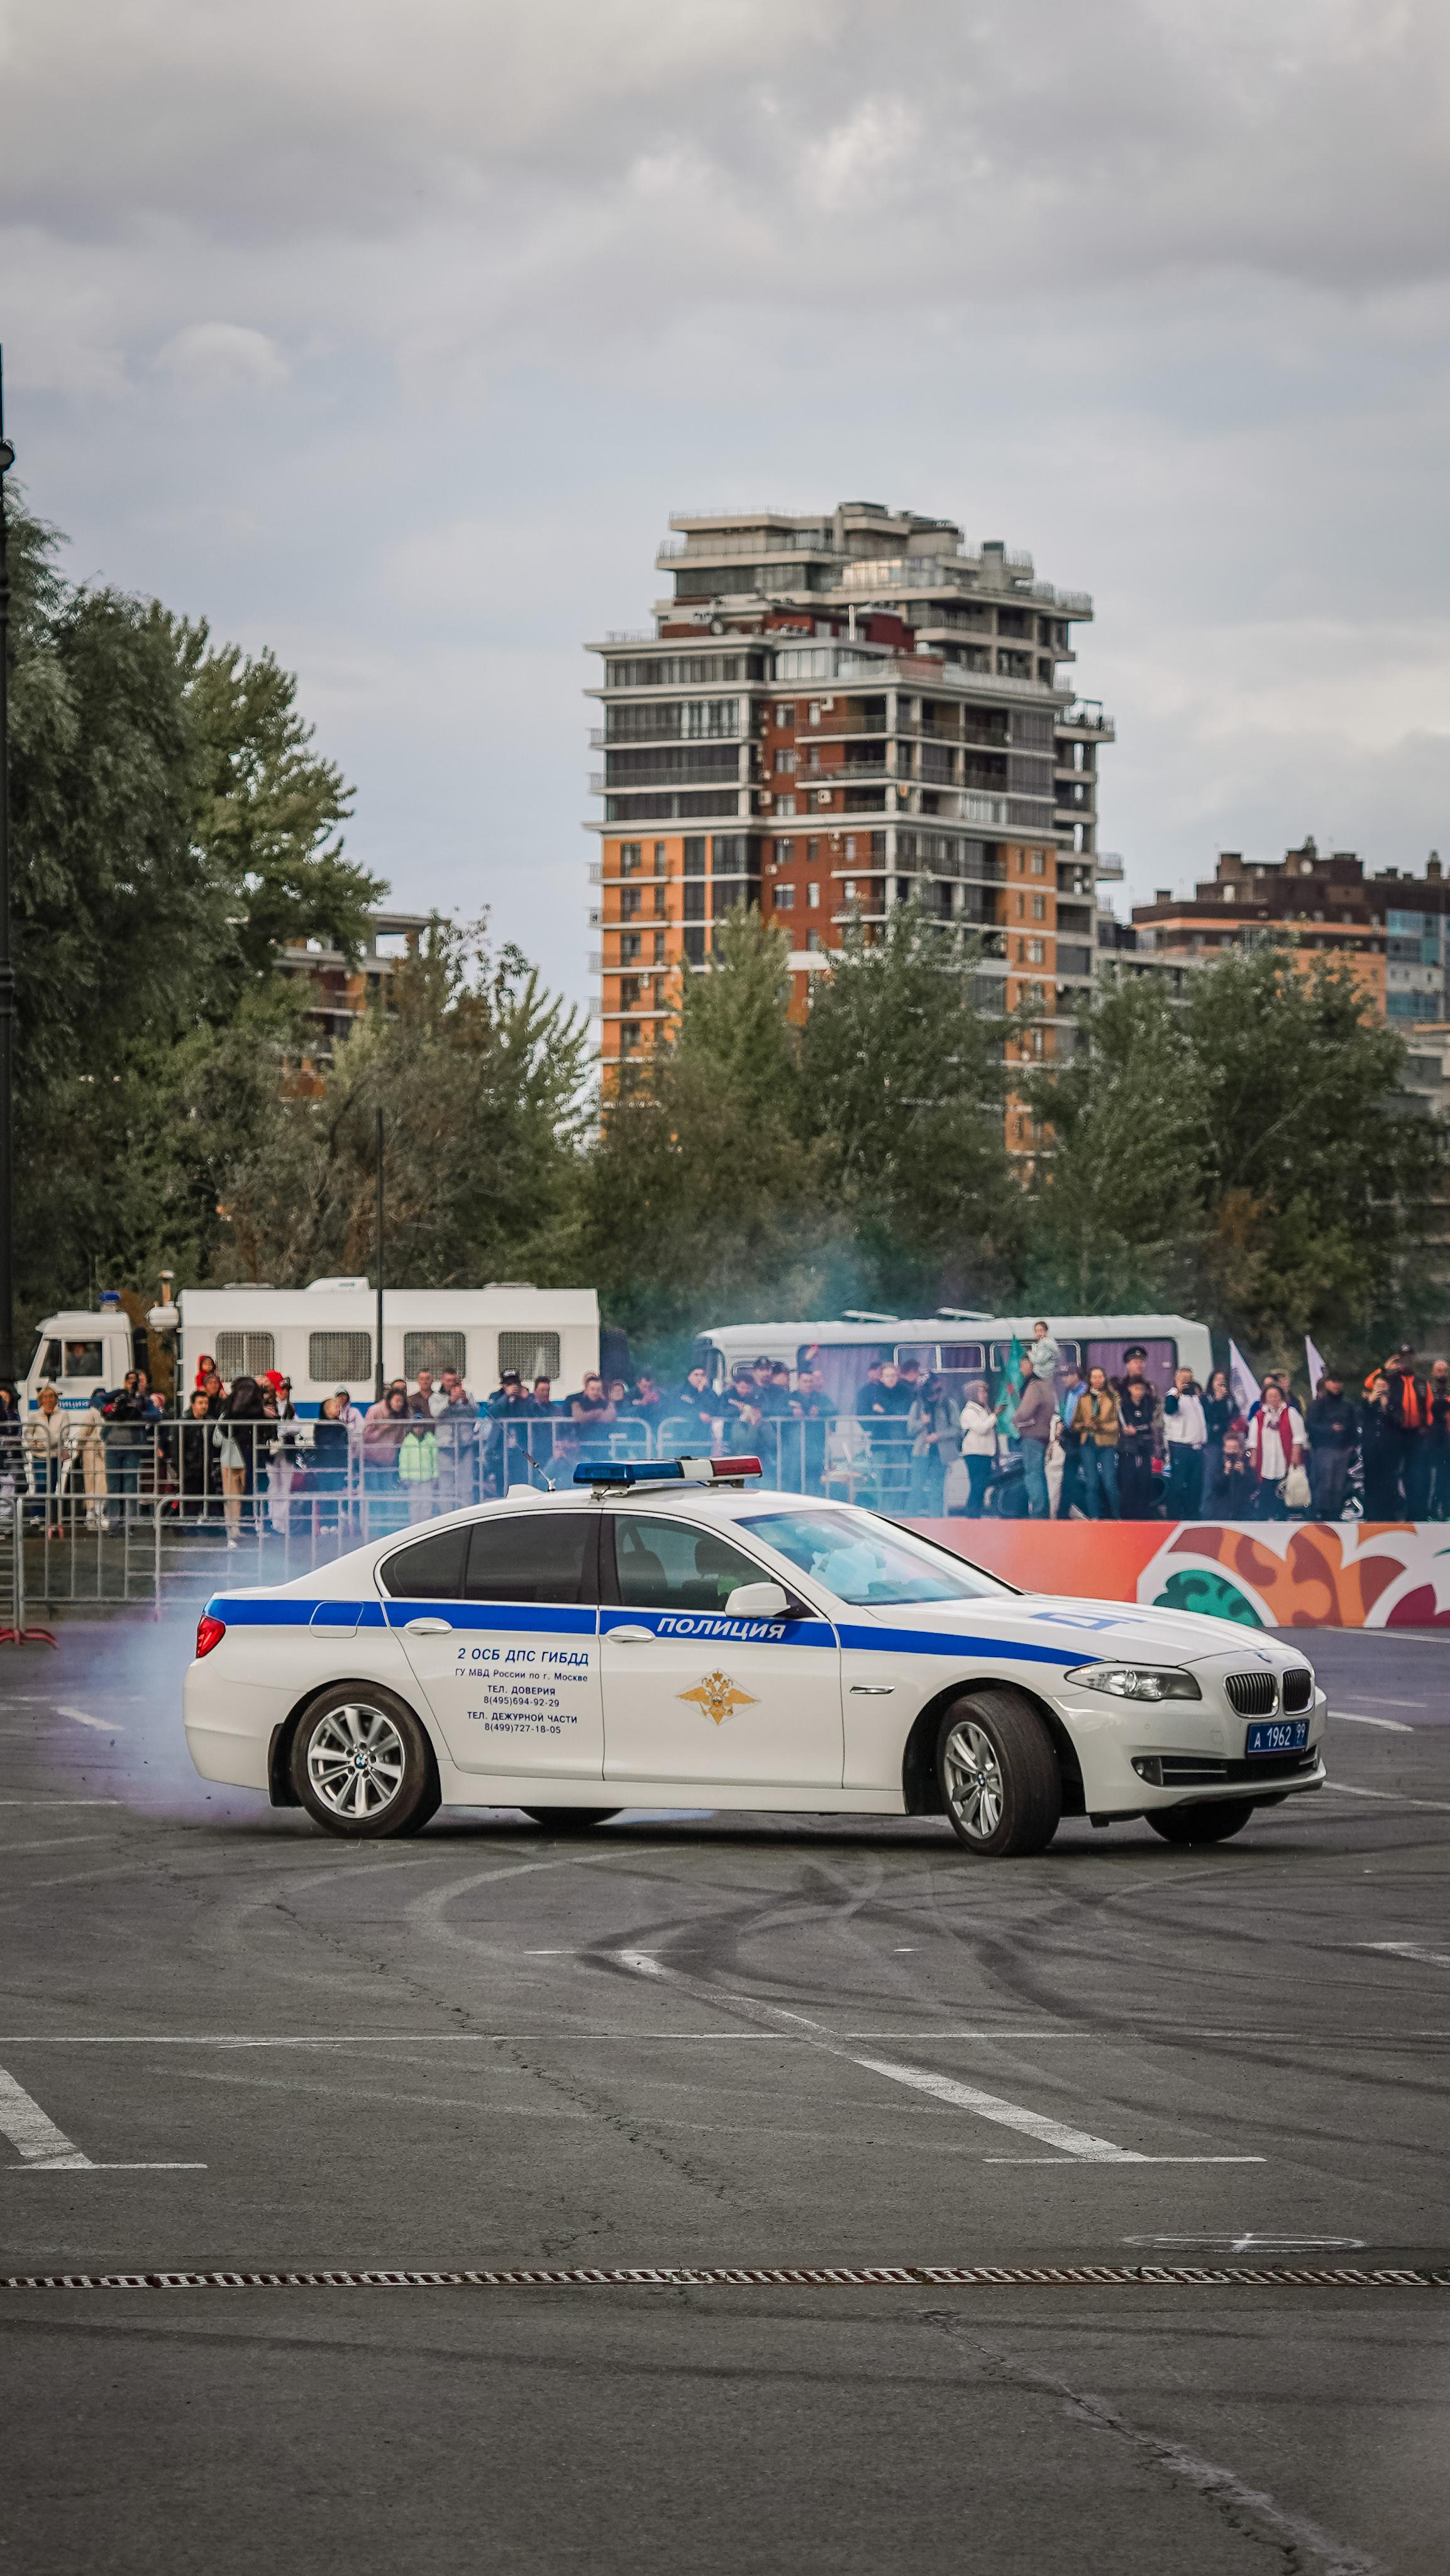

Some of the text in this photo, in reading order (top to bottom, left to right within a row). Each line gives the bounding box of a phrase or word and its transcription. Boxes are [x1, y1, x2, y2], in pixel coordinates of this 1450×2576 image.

[657, 1617, 786, 1640] ПОЛИЦИЯ
[457, 1648, 589, 1667] 2 ОСБ ДПС ГИБДД
[455, 1668, 465, 1676] ГУ
[468, 1668, 489, 1678] МВД
[493, 1670, 526, 1679] России
[554, 1673, 588, 1682] Москве
[487, 1685, 555, 1696] ТЕЛ. ДОВЕРИЯ
[484, 1696, 560, 1707] 8(495)694-92-29
[467, 1711, 577, 1724] ТЕЛ. ДЕЖУРНОЙ ЧАСТИ
[484, 1723, 561, 1734] 8(499)727-18-05
[1266, 1726, 1292, 1748] 1962
[1297, 1723, 1306, 1738] 99
